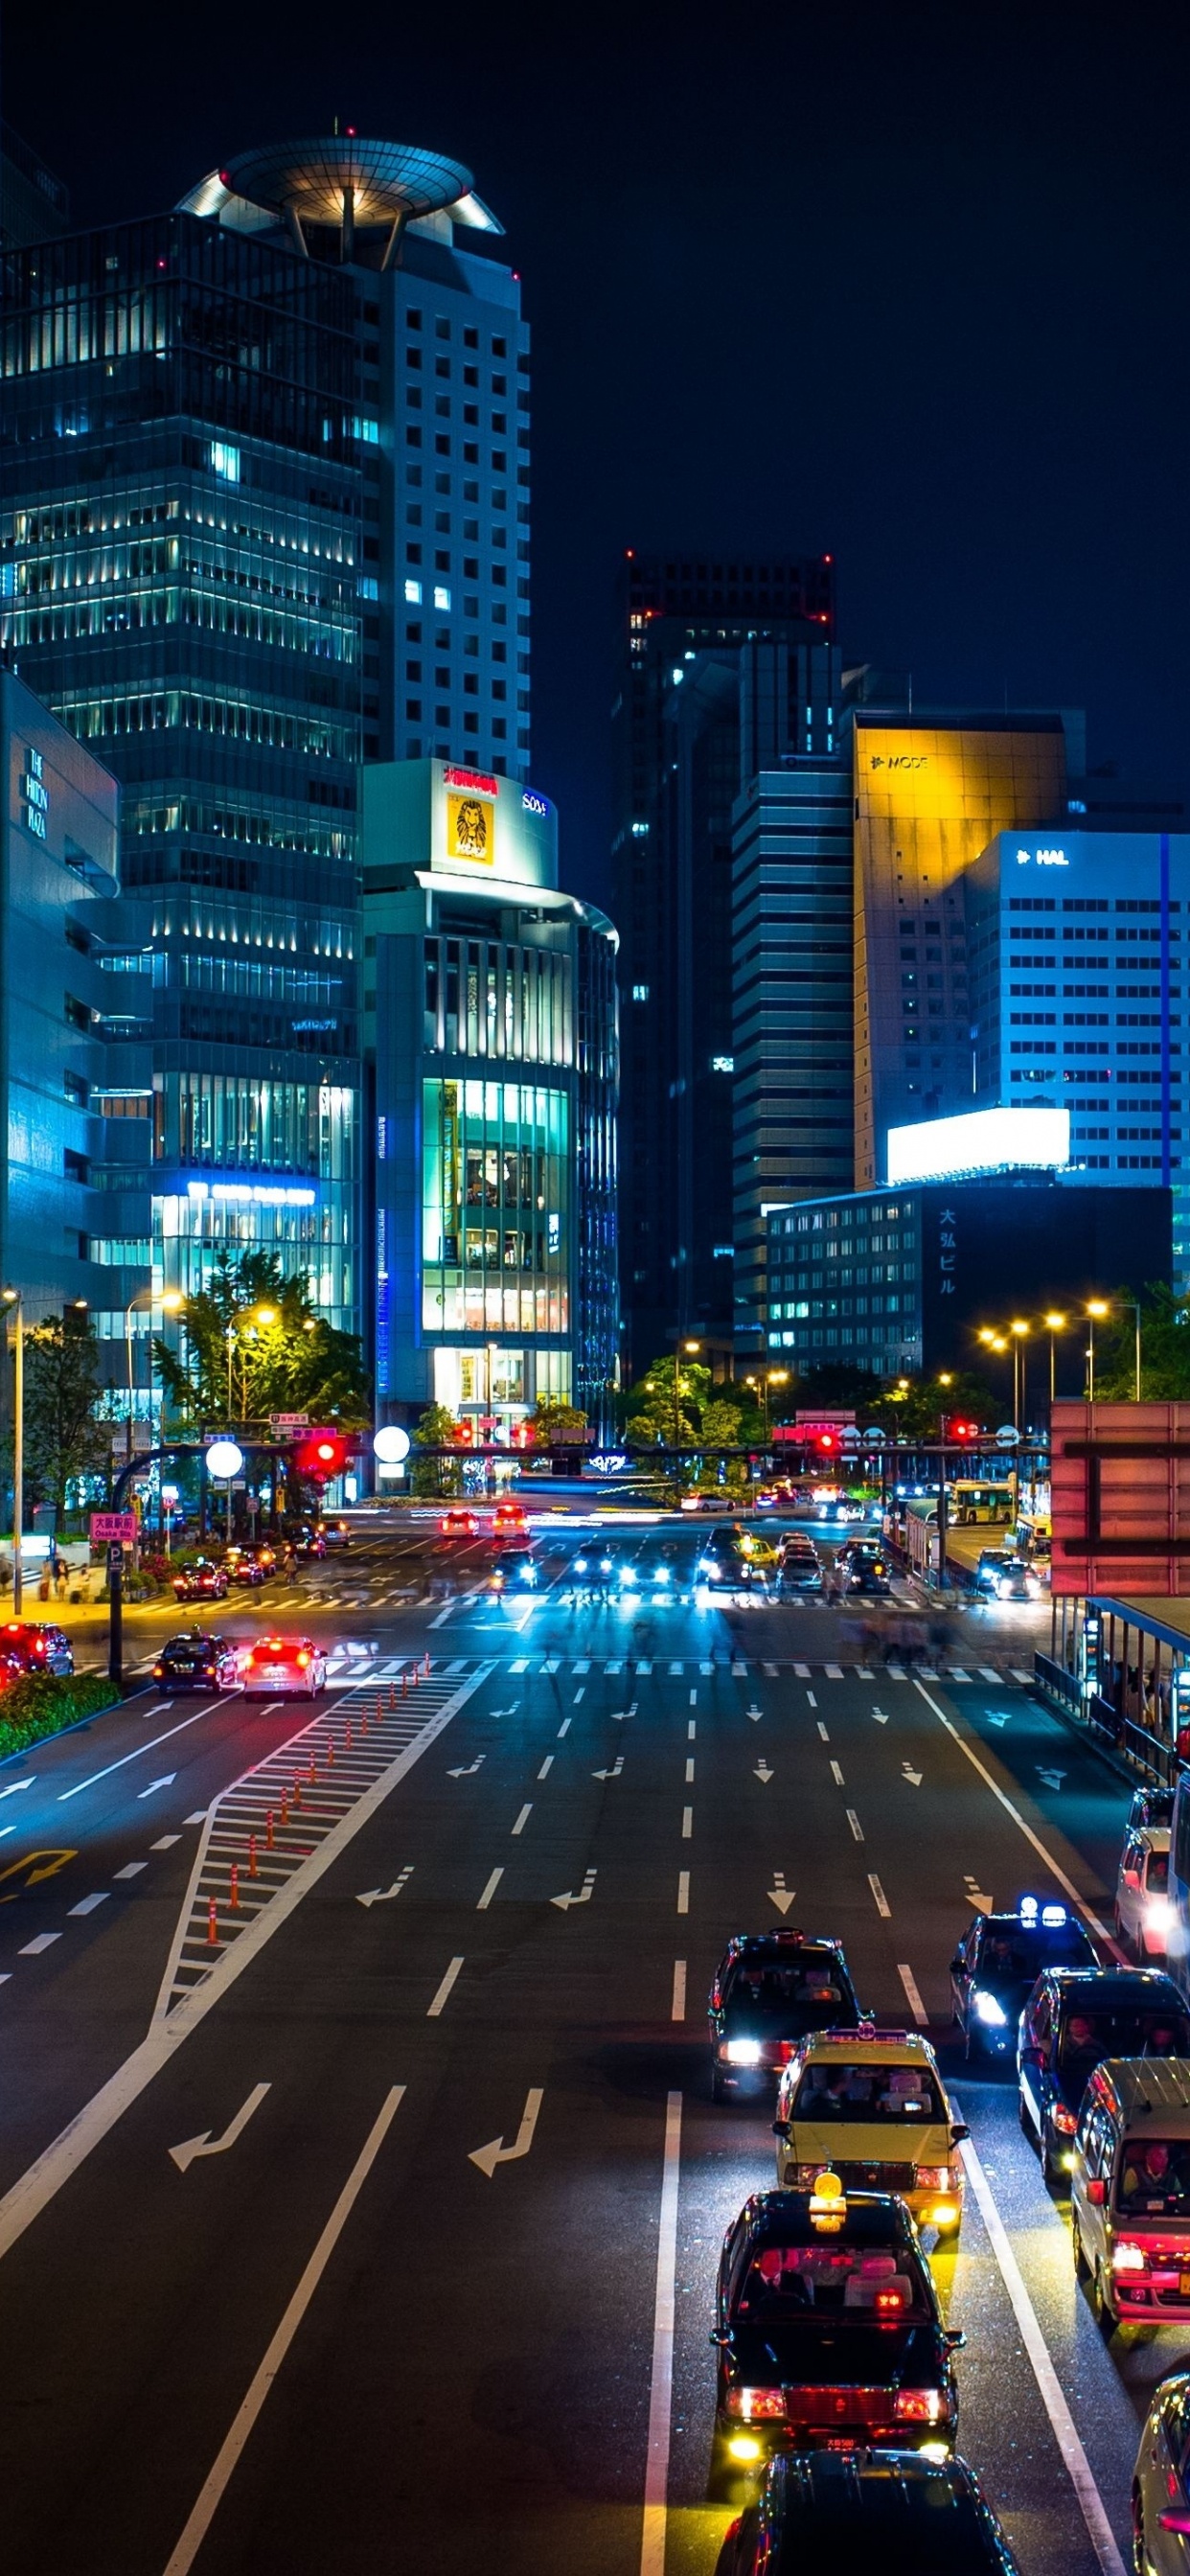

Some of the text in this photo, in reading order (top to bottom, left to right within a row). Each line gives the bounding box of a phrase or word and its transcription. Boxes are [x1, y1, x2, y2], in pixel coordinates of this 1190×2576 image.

[31, 748, 42, 780] THE
[888, 756, 928, 769] MODE
[28, 805, 46, 840] PLAZA
[1036, 849, 1069, 865] HAL
[940, 1208, 956, 1294] 大弘ビル
[96, 1517, 132, 1530] 大阪駅前
